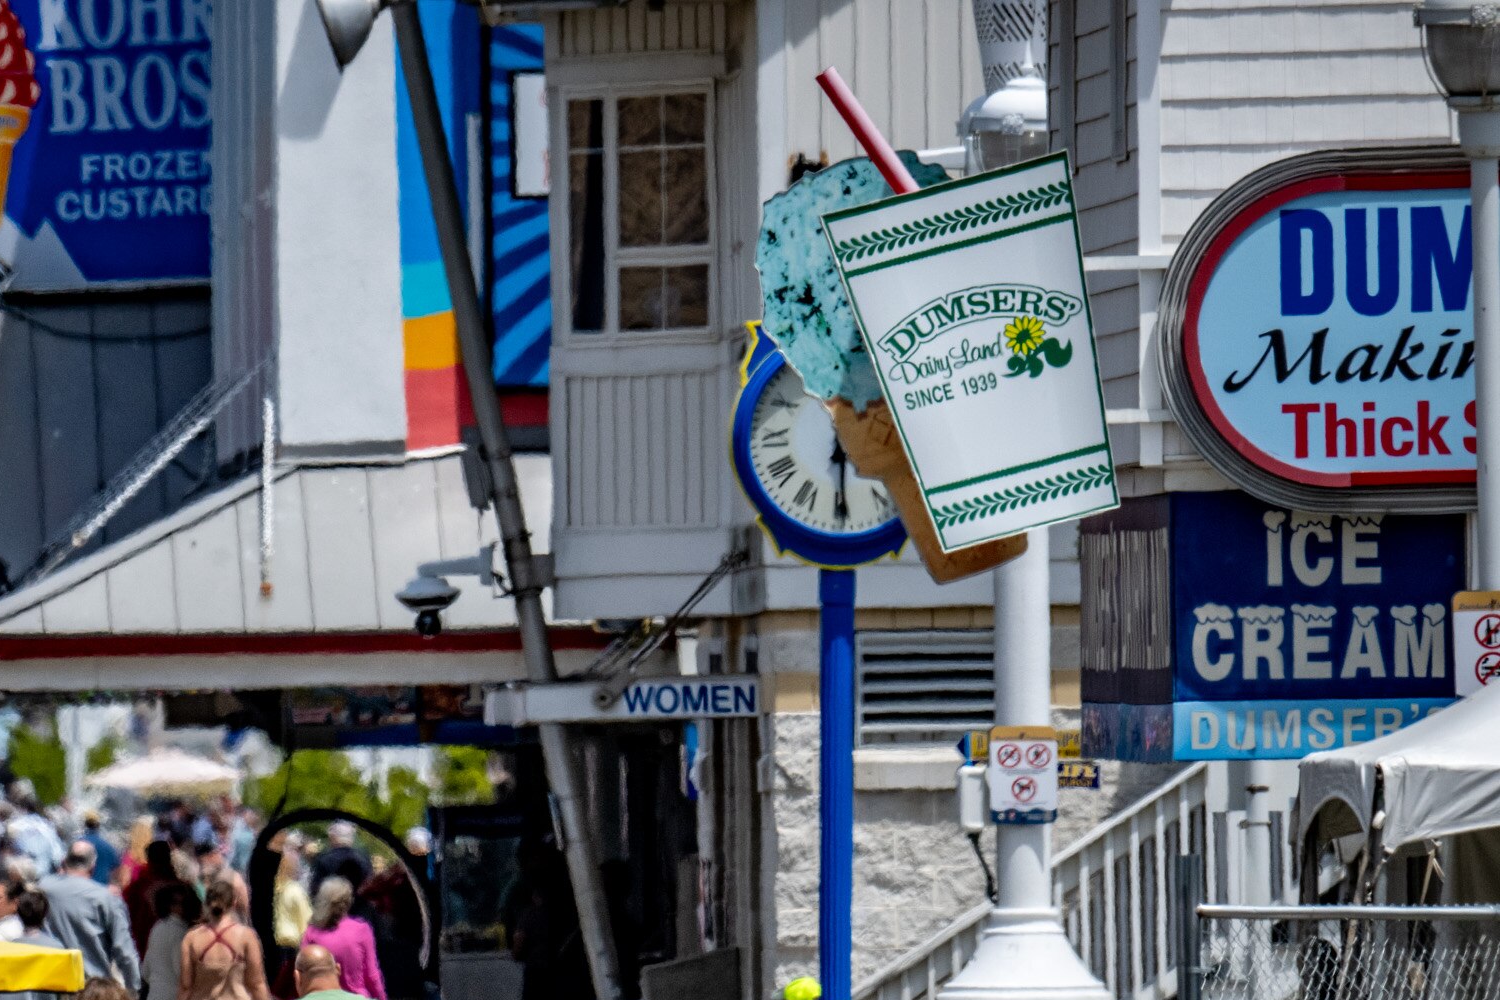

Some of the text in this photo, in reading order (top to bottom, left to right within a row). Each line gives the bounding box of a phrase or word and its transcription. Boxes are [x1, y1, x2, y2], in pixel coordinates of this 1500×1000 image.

[46, 53, 211, 133] BROS
[884, 288, 1076, 359] DUMSERS'
[888, 332, 1004, 385] Dairy Land
[903, 371, 998, 411] SINCE 1939
[1281, 400, 1452, 460] Thick
[1262, 510, 1387, 587] ICE
[1191, 602, 1446, 682] CREAM
[624, 685, 757, 714] WOMEN
[1190, 703, 1448, 751] DUMSER'
